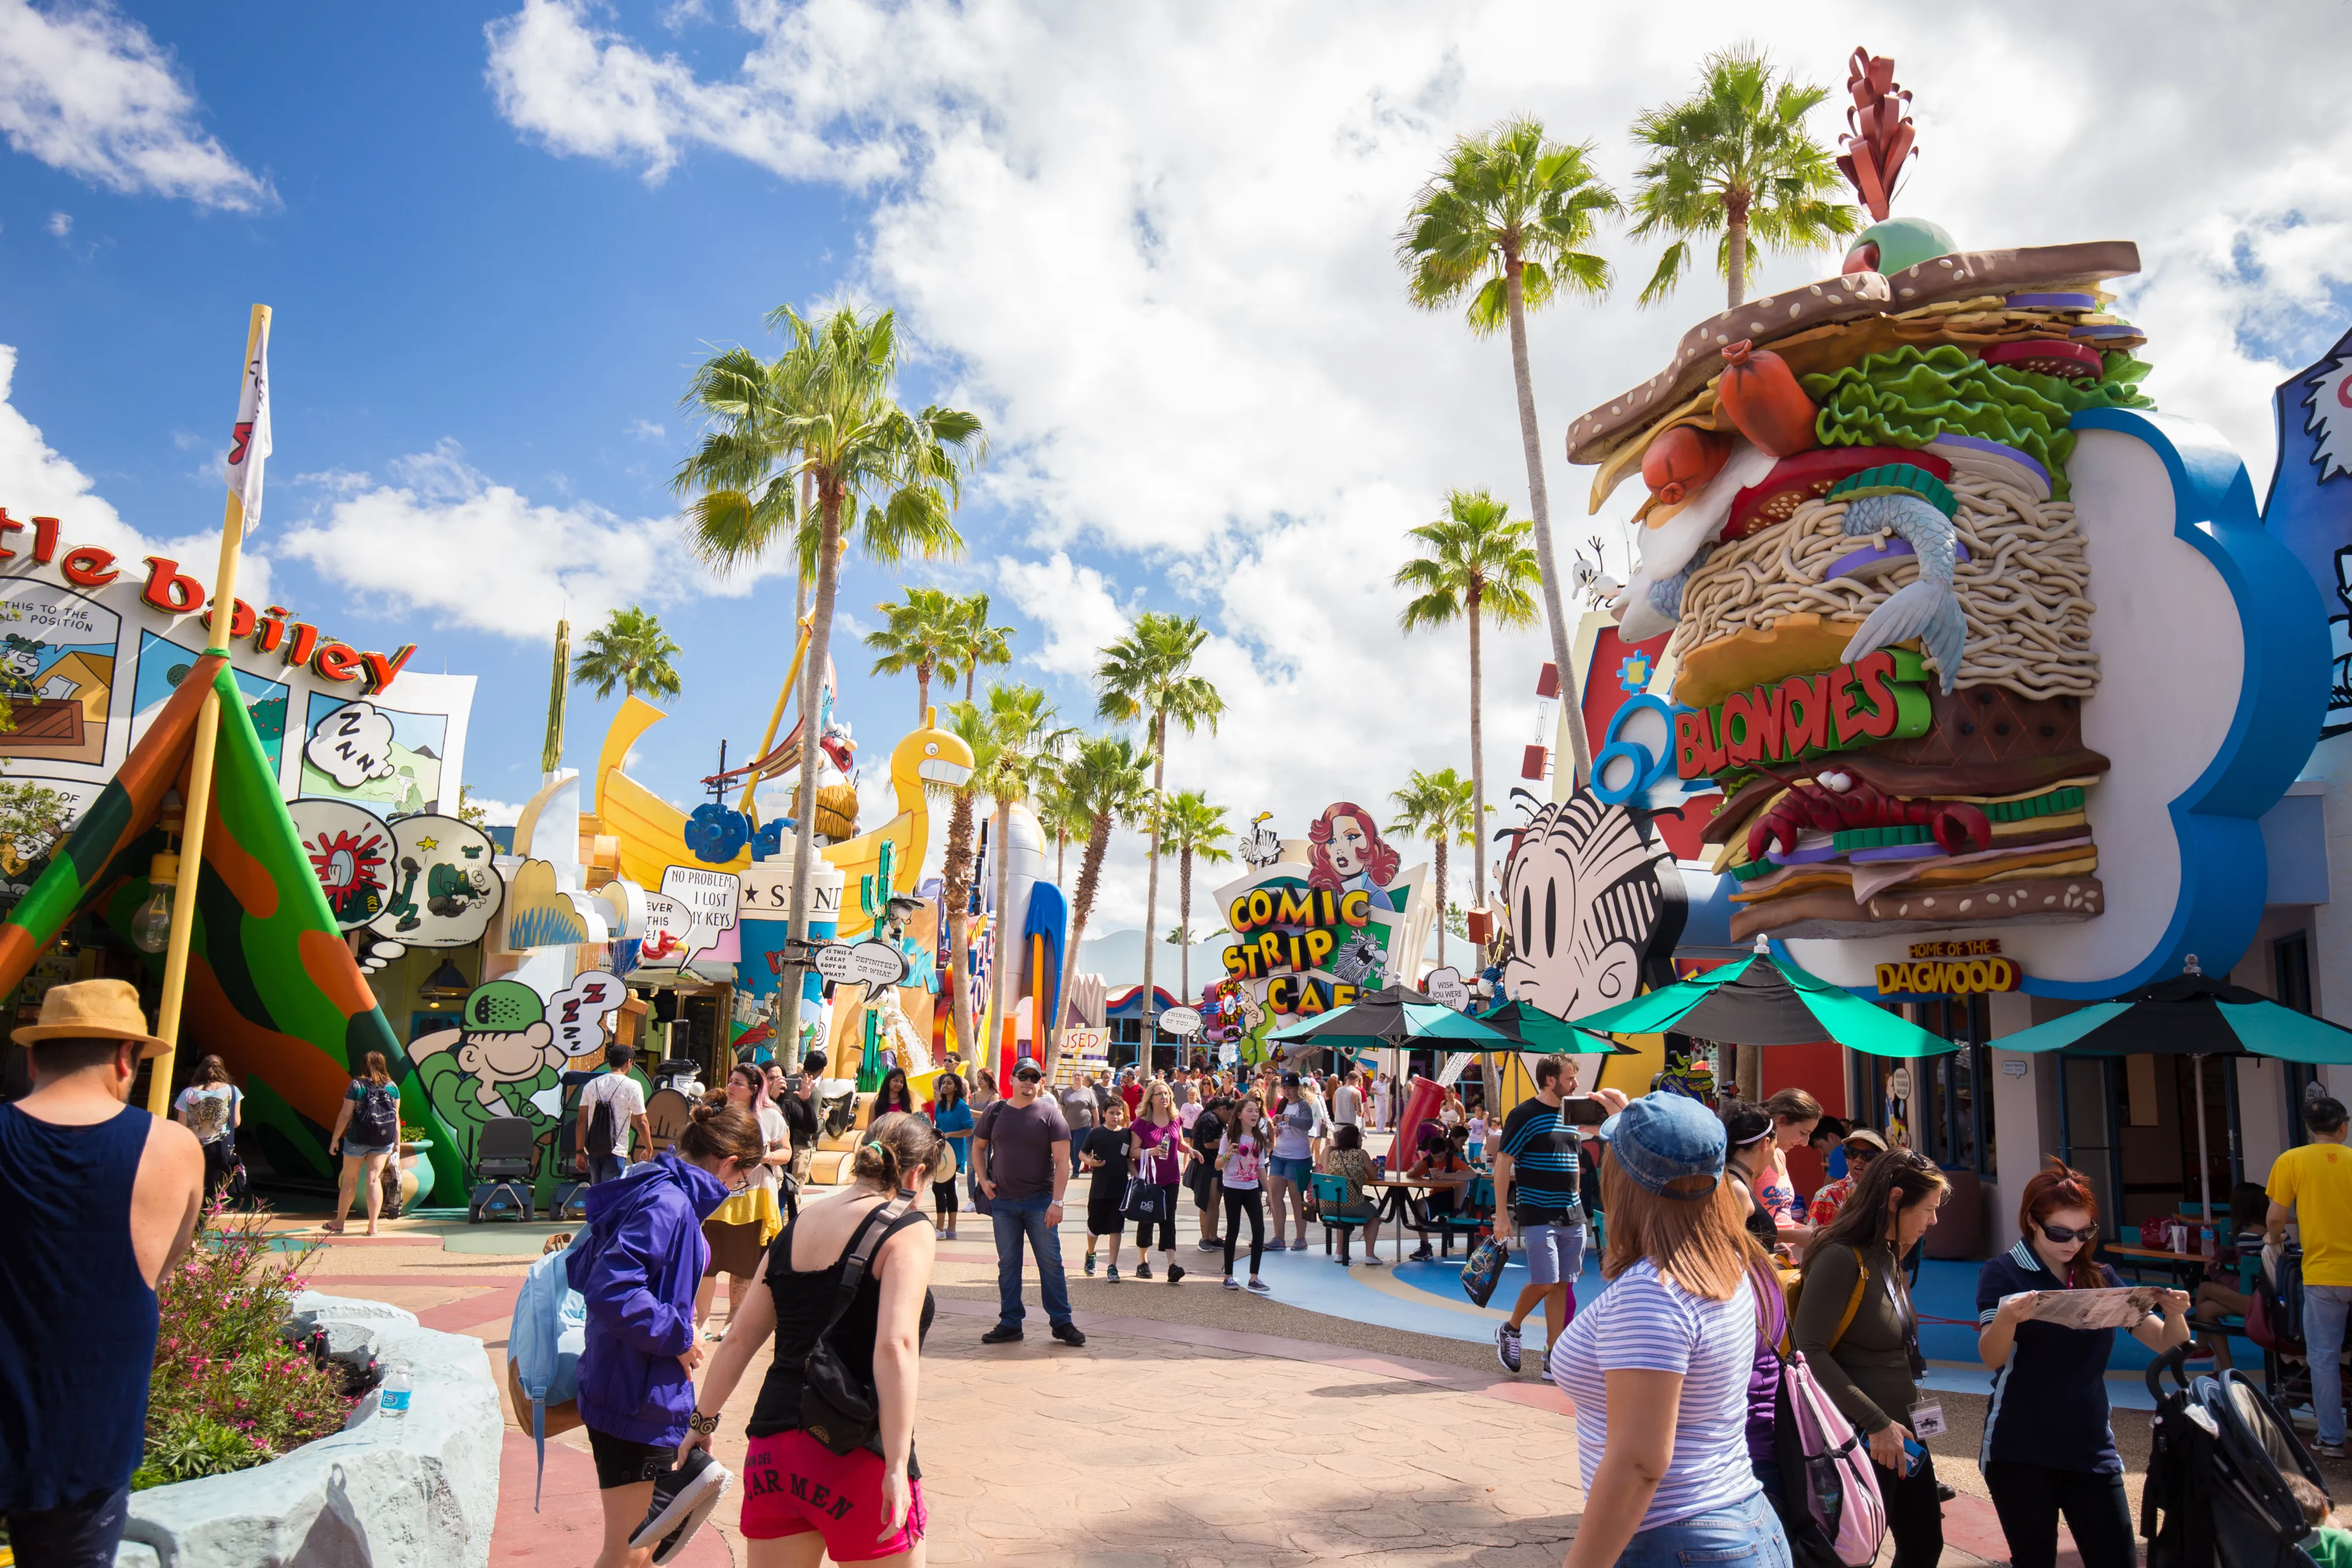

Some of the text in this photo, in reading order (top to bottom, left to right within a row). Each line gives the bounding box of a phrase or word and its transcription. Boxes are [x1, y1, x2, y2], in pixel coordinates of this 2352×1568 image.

[4, 601, 89, 619] THIS TO THE
[31, 614, 93, 632] POSITION
[140, 555, 418, 697] bailey
[58, 792, 81, 803] OF
[671, 870, 734, 890] NO PROBLEM,
[695, 891, 728, 907] I LOST
[771, 884, 842, 910] SND
[1229, 884, 1371, 934] COMIC
[647, 916, 669, 926] THIS
[1223, 928, 1334, 982] STRIP
[1909, 940, 1992, 958] HOME OF THE
[855, 956, 899, 970] DEFINITELY
[1875, 956, 2013, 995] DAGWOOD
[1267, 976, 1371, 1017] CAF
[1432, 990, 1444, 999] YOU
[1438, 998, 1457, 1007] ERE!
[1167, 1011, 1198, 1020] THINKING
